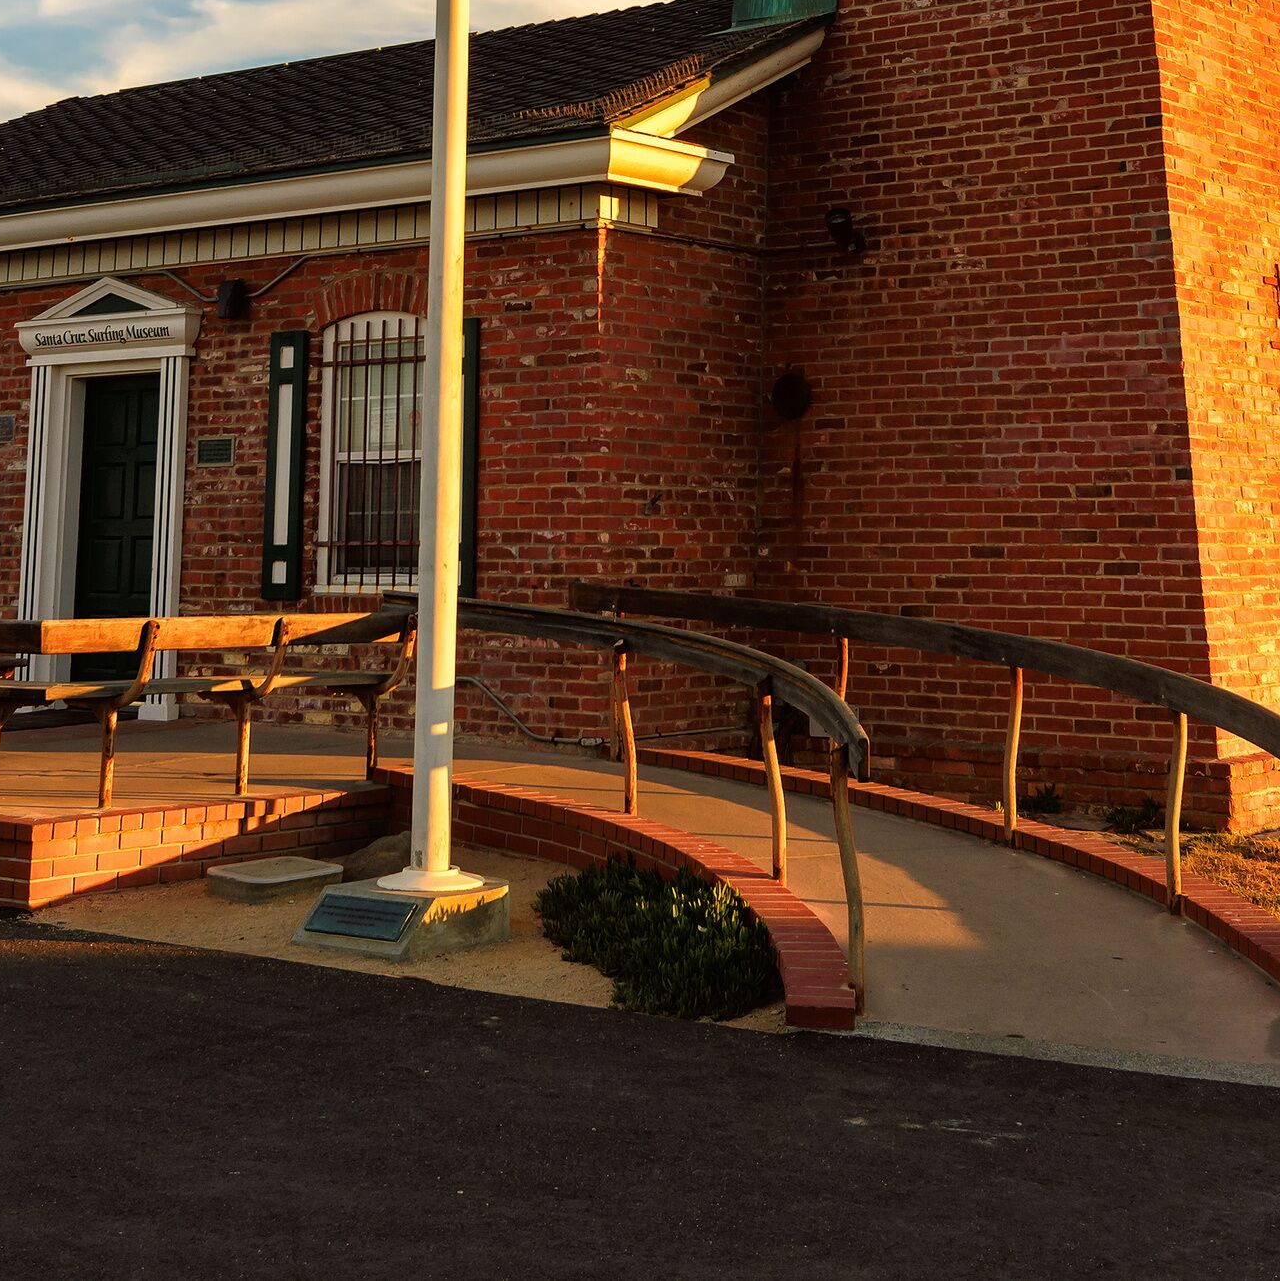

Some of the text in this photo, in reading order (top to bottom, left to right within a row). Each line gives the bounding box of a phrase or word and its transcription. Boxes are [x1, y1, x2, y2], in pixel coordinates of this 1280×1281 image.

[35, 325, 170, 347] Santa Cruz Surfing Museum
